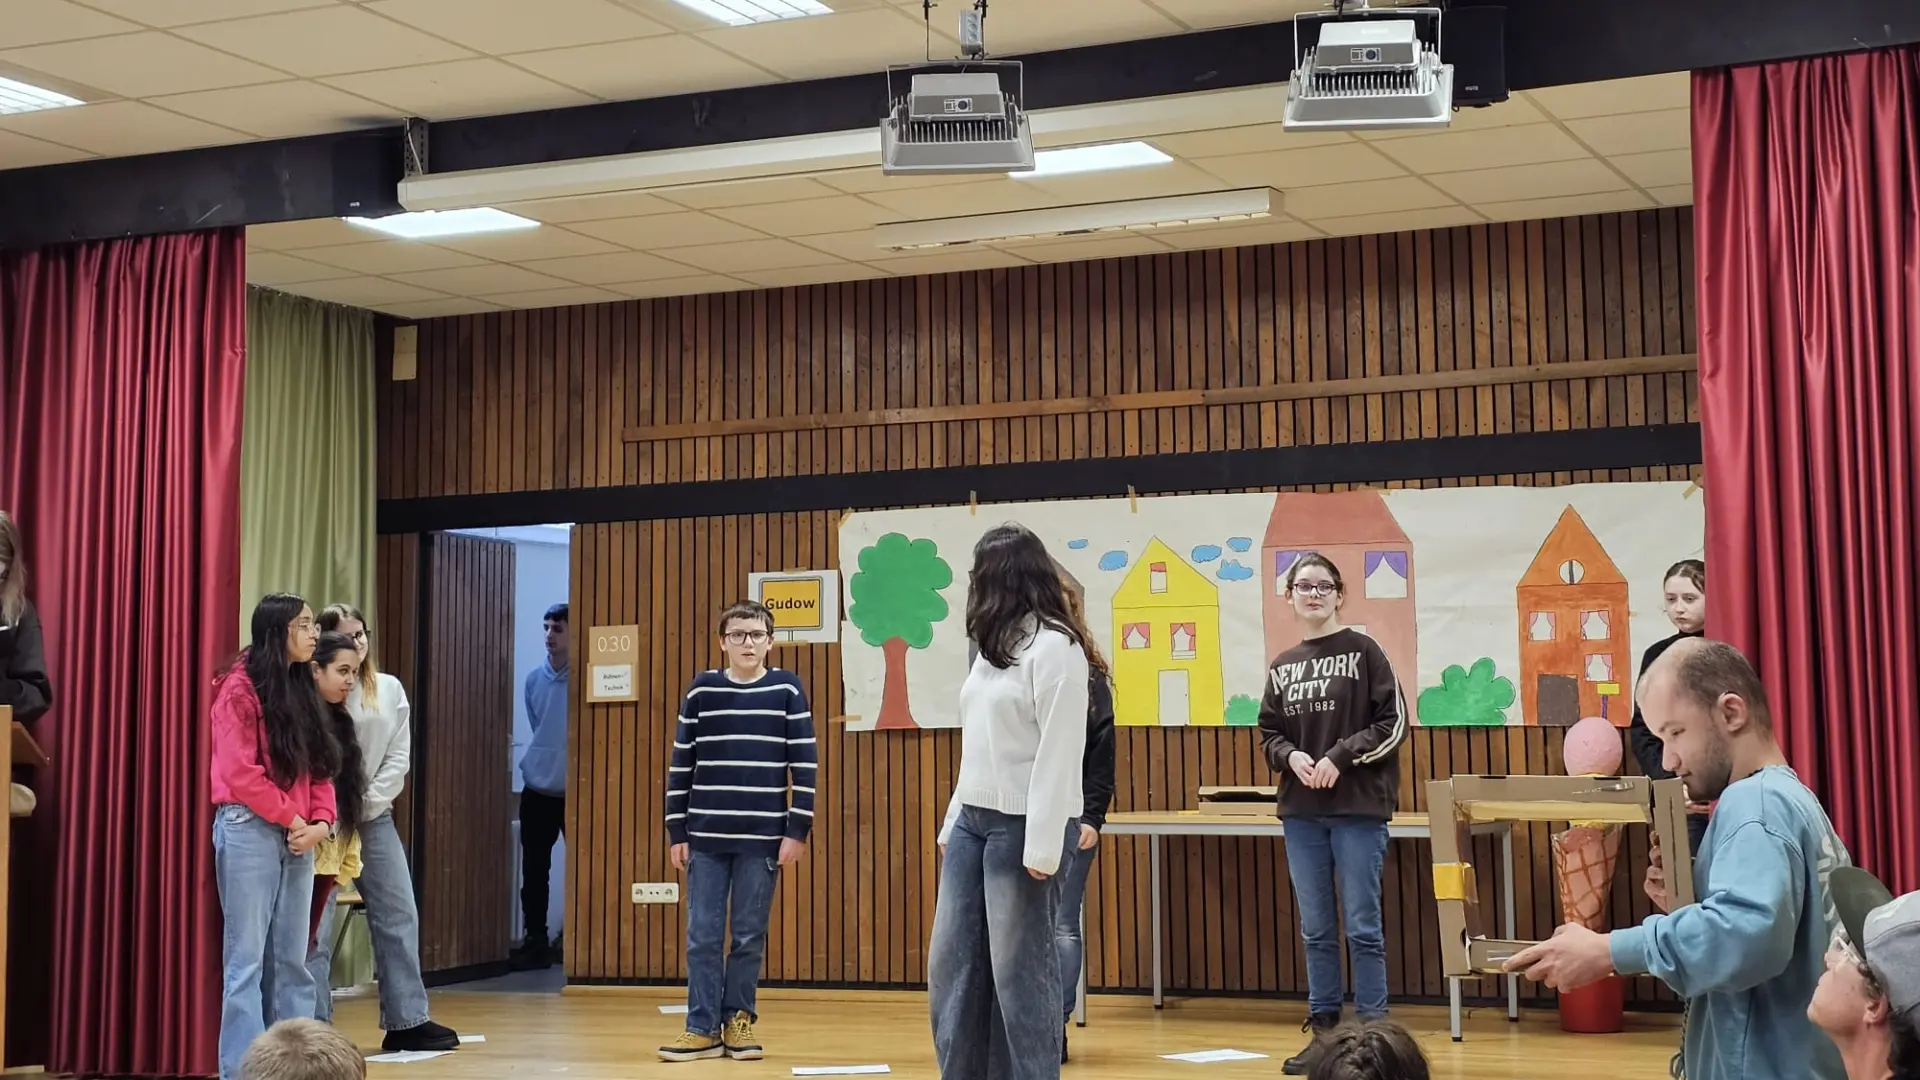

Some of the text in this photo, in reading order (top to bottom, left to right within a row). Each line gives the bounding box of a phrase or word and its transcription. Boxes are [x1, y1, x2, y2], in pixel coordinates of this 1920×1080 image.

[765, 597, 815, 610] Gudow
[1270, 652, 1361, 695] NEW YORK
[1287, 679, 1331, 701] CITY
[1284, 700, 1335, 717] EST. 1982
